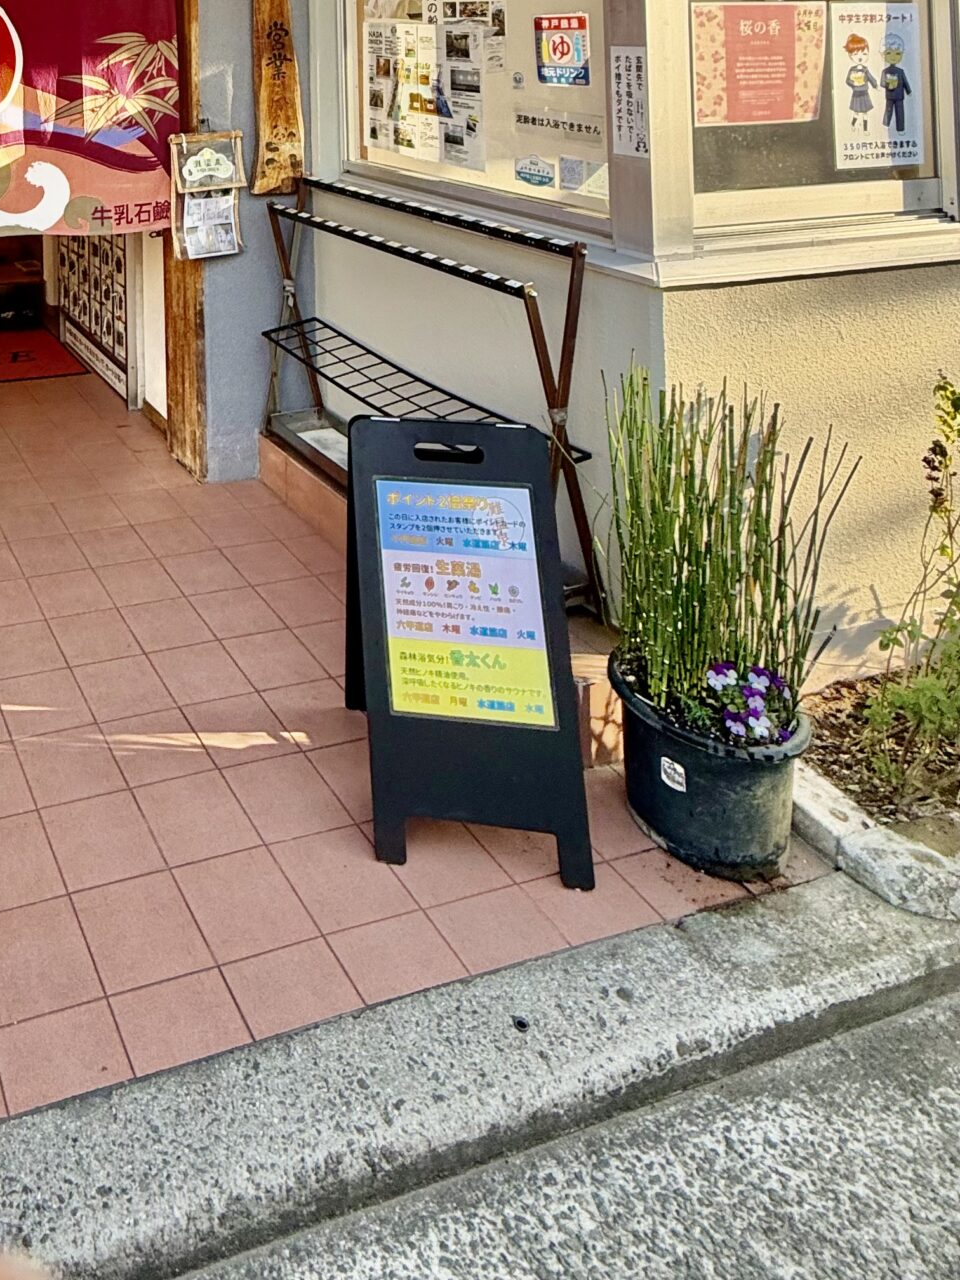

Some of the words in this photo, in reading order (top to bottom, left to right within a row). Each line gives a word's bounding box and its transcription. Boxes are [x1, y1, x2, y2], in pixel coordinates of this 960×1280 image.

[739, 18, 781, 36] 桜の香
[552, 35, 571, 60] ゆ
